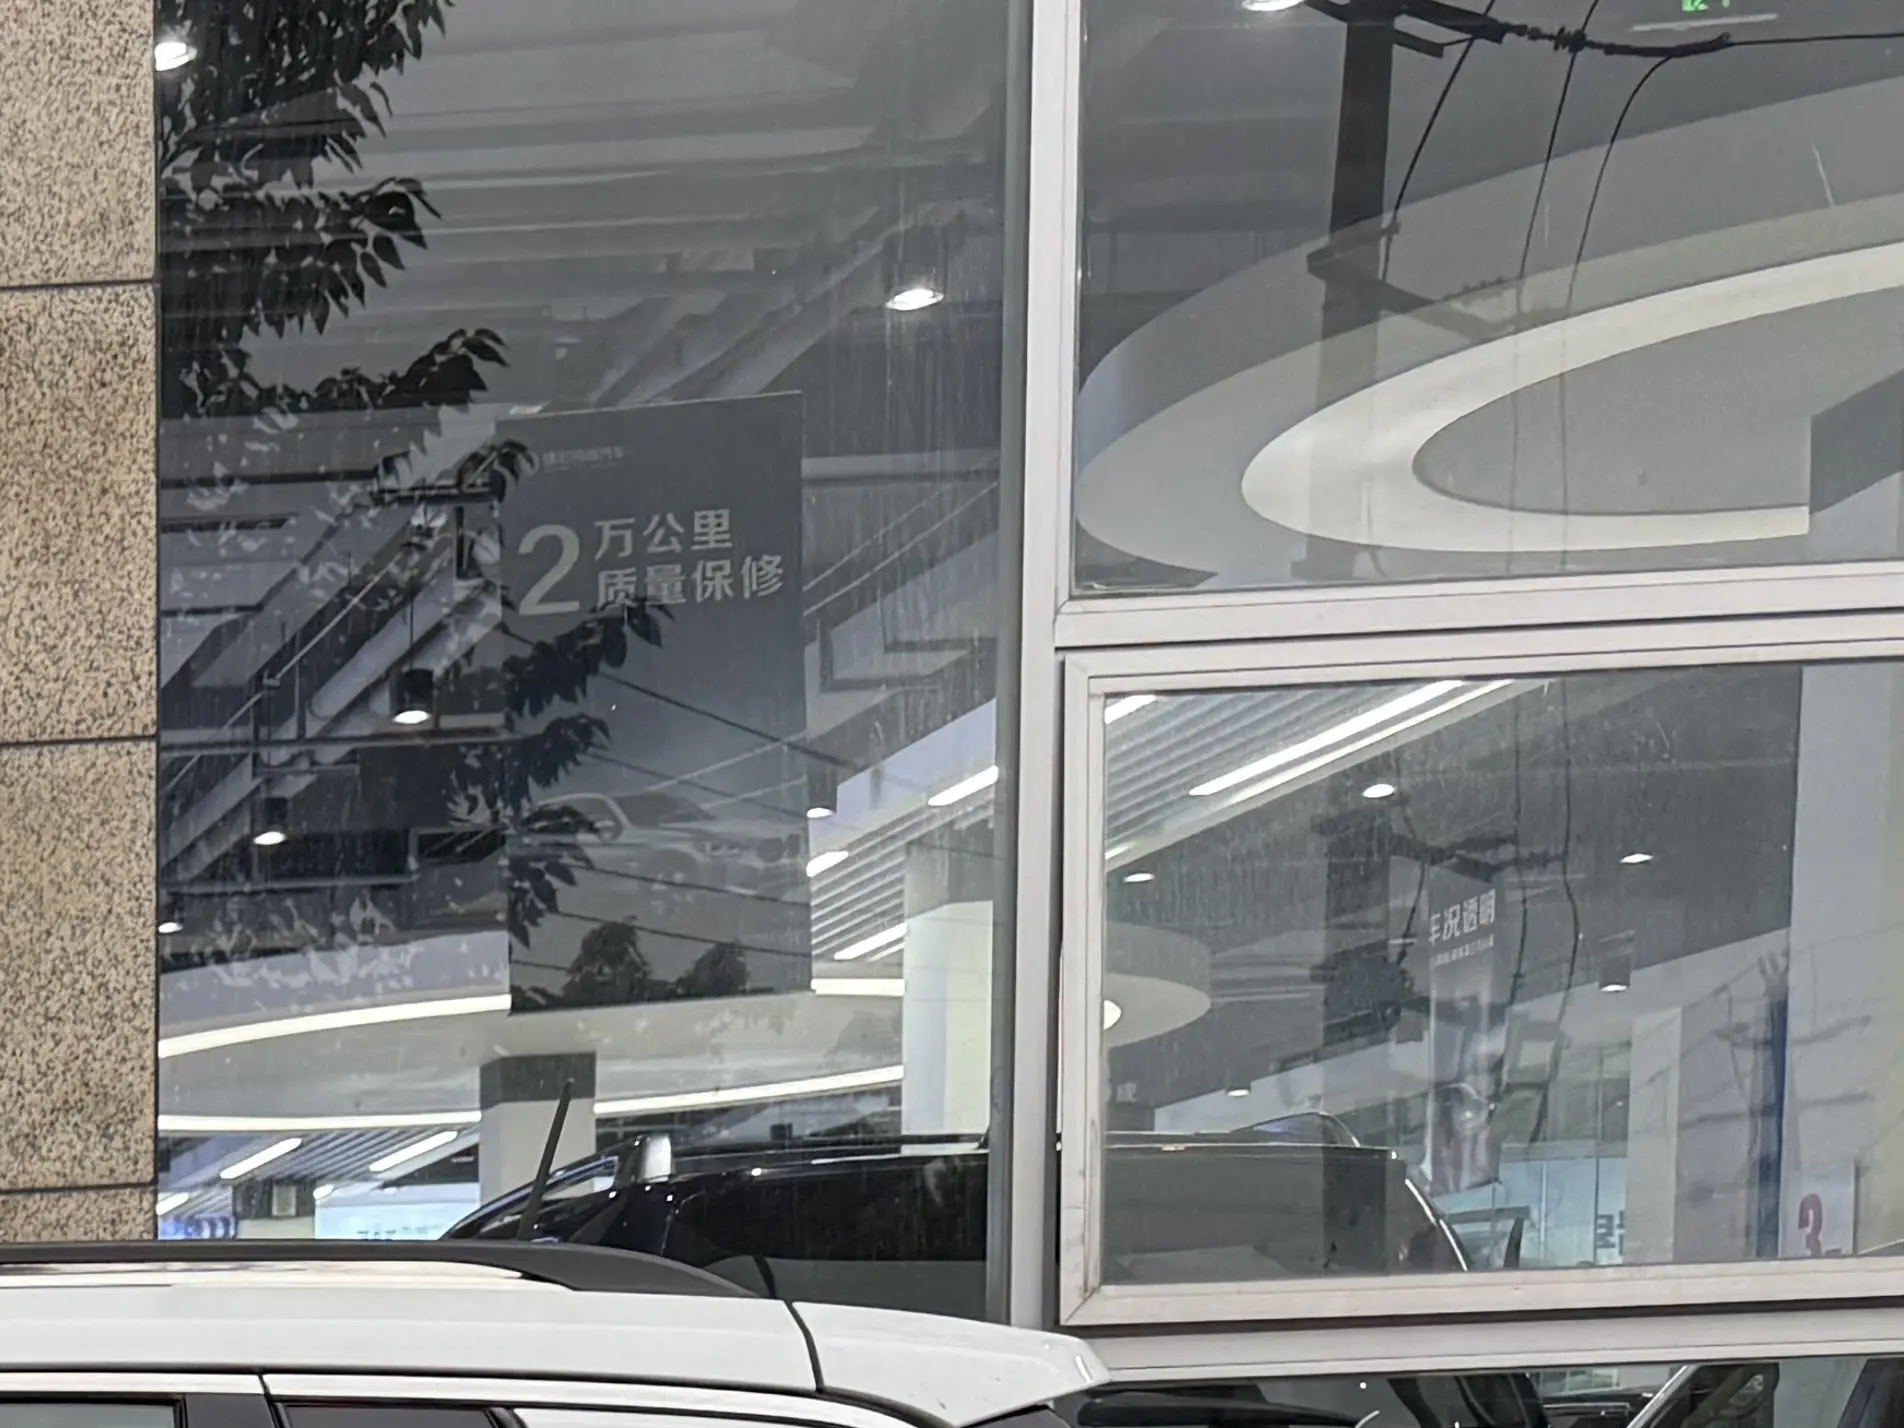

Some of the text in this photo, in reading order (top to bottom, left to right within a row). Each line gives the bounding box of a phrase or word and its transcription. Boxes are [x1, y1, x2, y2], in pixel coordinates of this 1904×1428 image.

[518, 508, 734, 617] 2 万公里
[596, 554, 785, 611] 质量保修
